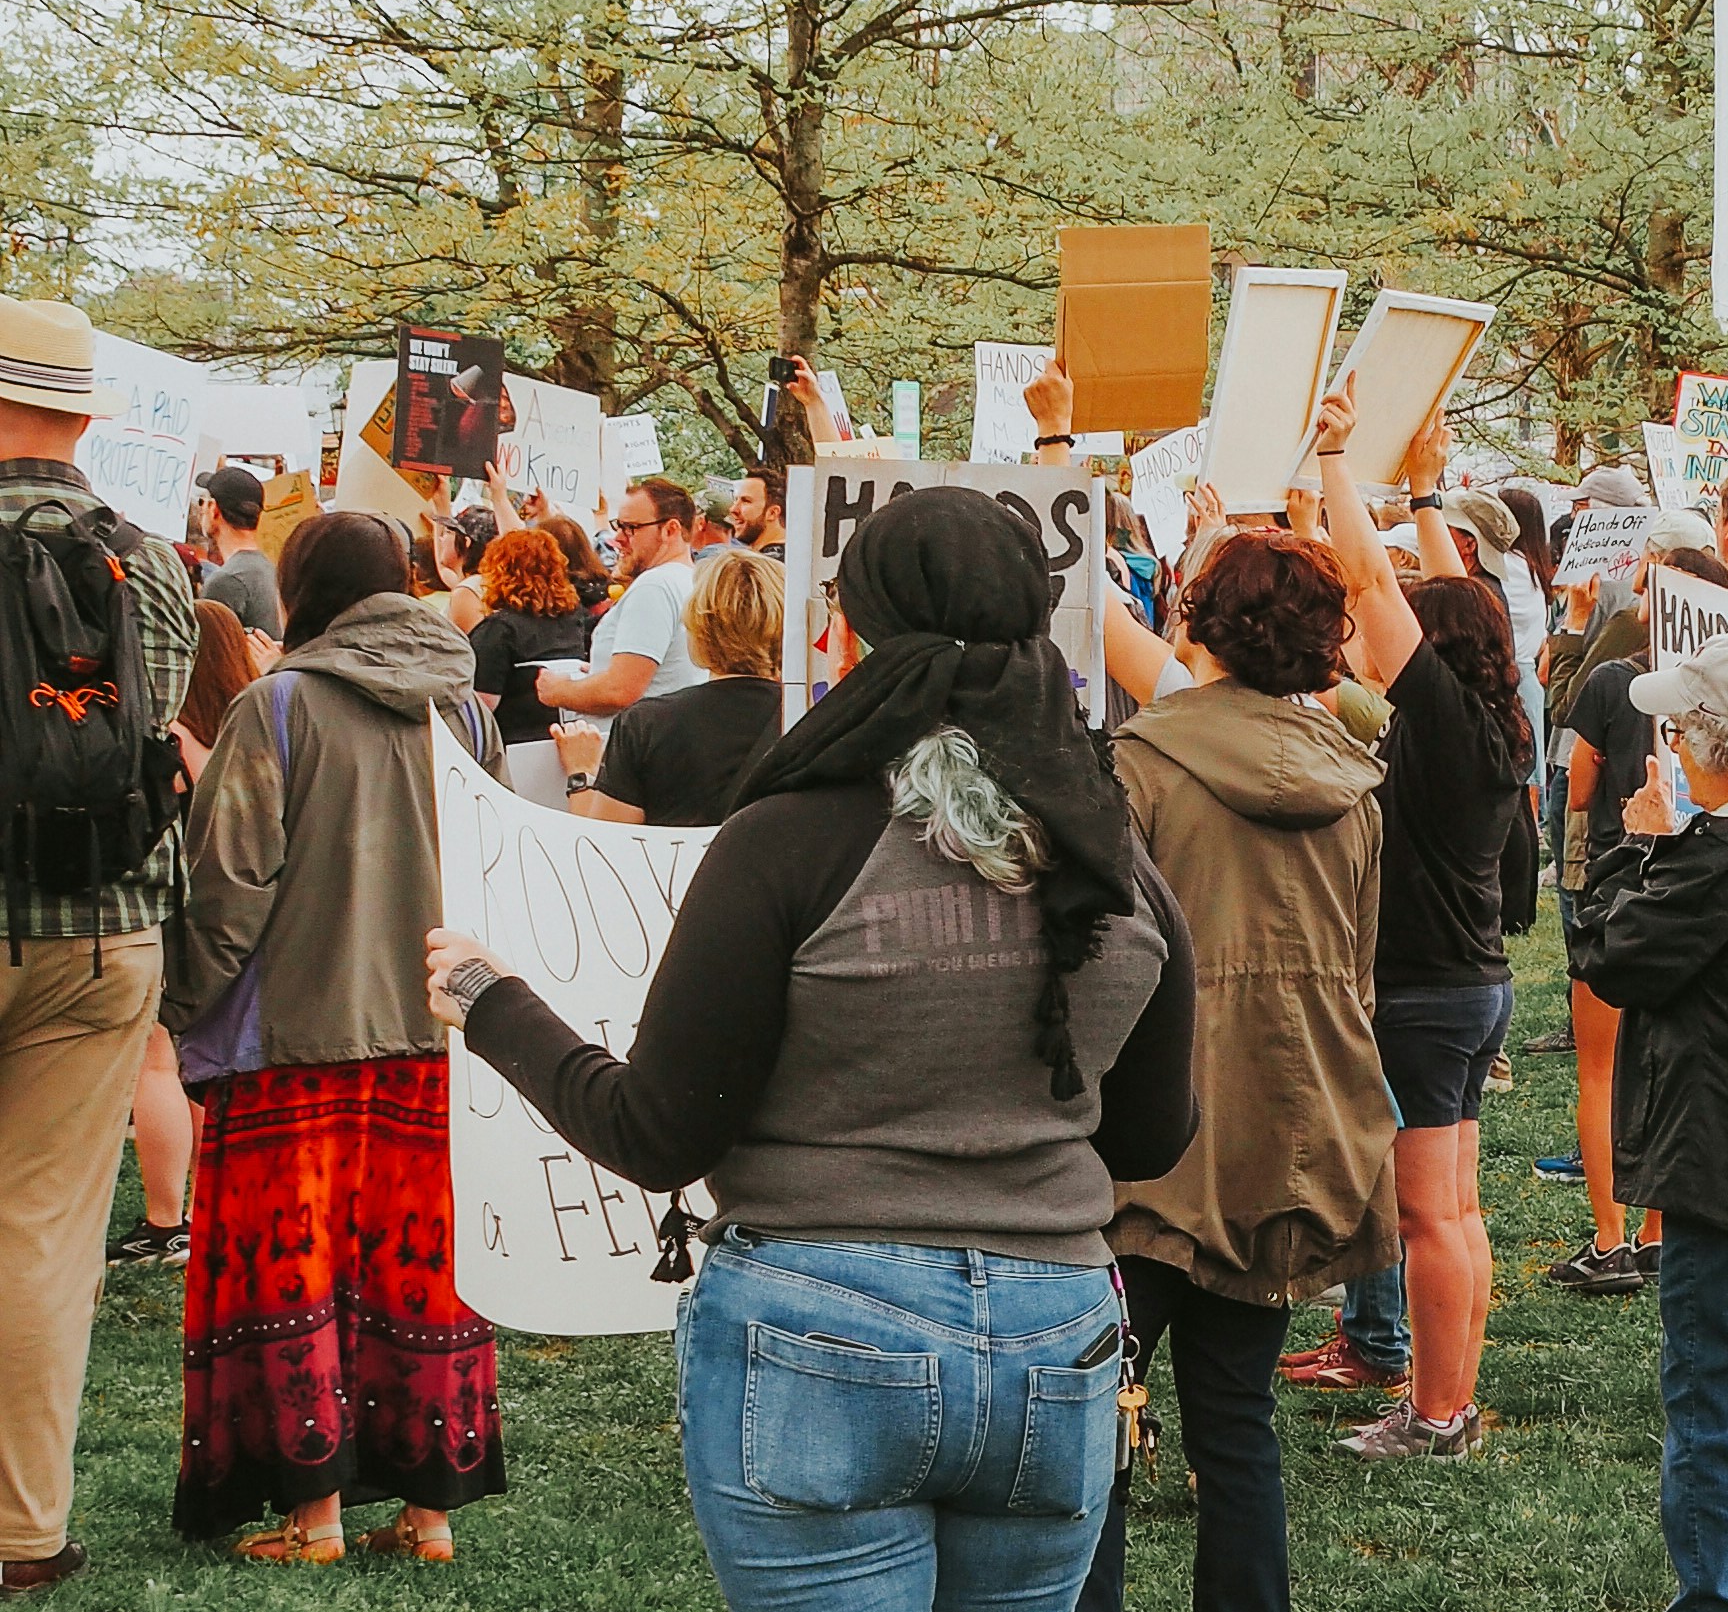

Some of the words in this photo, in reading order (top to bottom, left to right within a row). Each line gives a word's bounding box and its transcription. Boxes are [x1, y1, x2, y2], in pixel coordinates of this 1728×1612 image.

[979, 349, 1048, 385] HANDS
[127, 385, 142, 426] A
[152, 390, 191, 436] PAID
[497, 443, 521, 478] NO
[526, 444, 579, 503] King
[1134, 440, 1182, 493] HANDS
[1184, 427, 1209, 464] OF
[1567, 537, 1610, 554] Medicaid
[1611, 537, 1633, 547] and
[1576, 513, 1620, 538] Hands
[1622, 515, 1648, 530] Off
[1564, 556, 1609, 572] Medicare
[442, 765, 714, 983] CROOK
